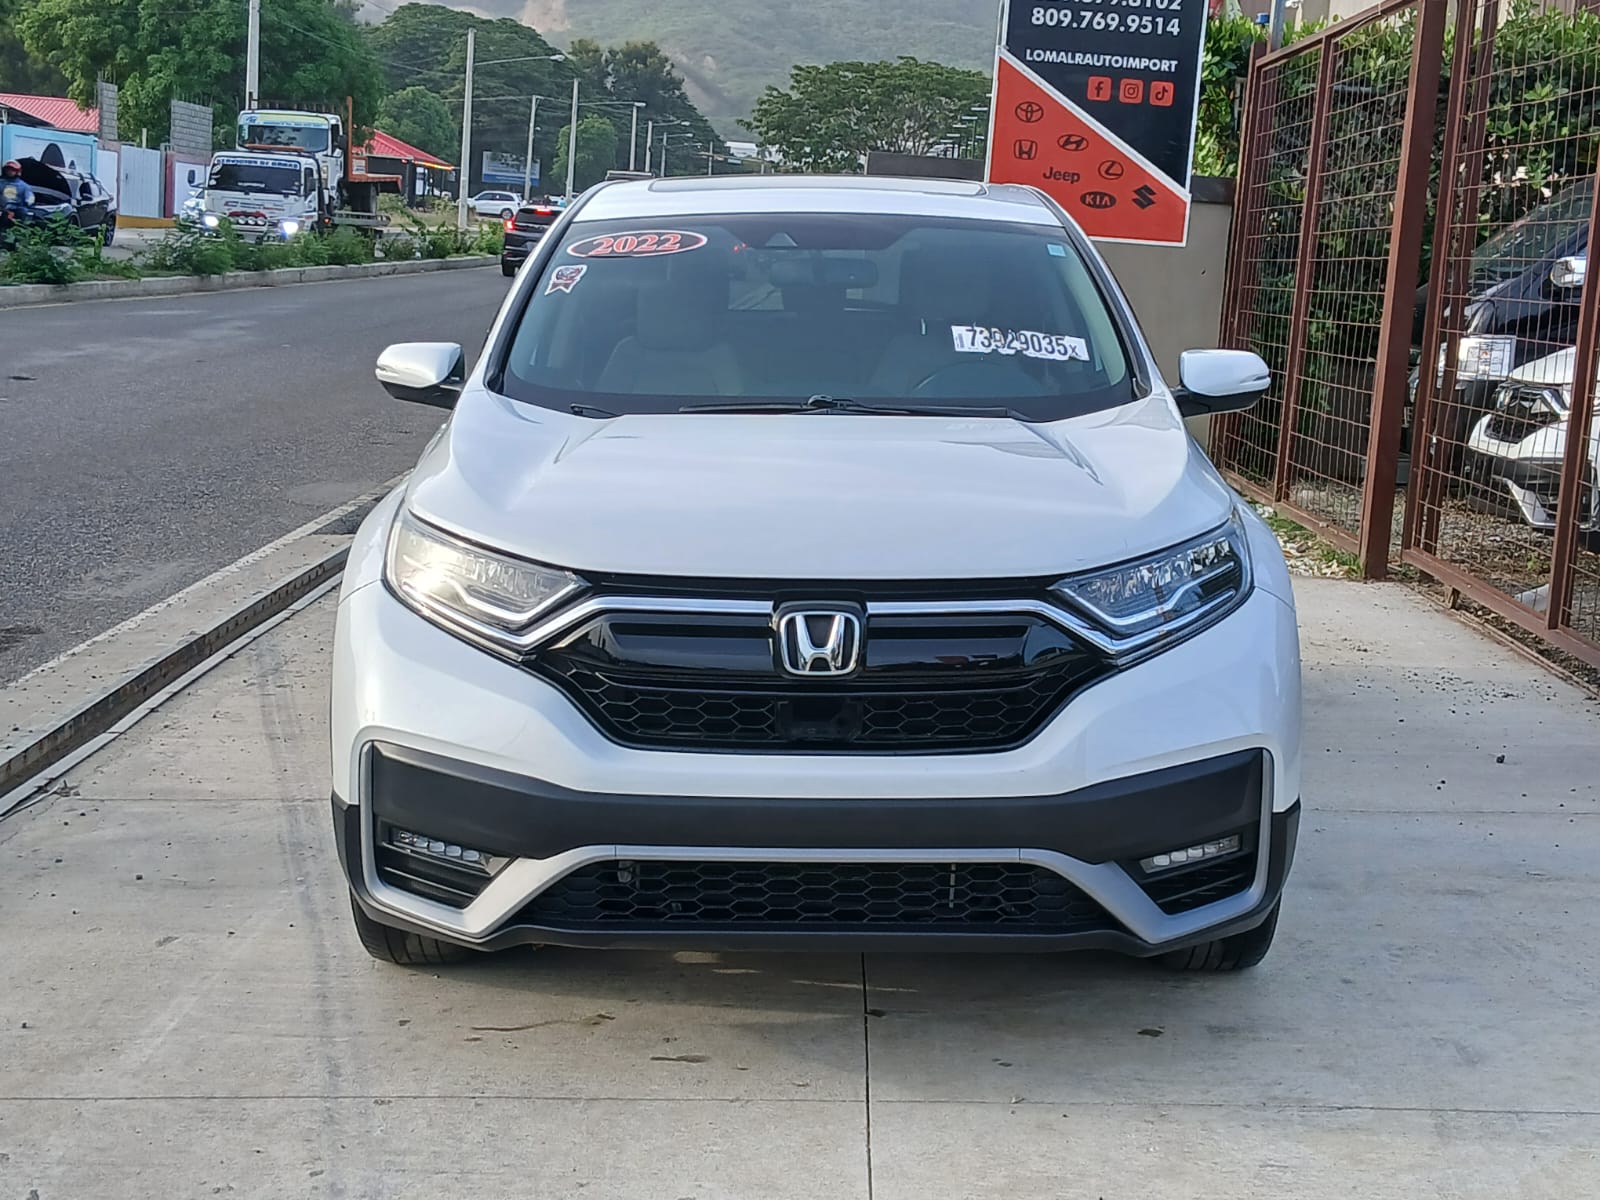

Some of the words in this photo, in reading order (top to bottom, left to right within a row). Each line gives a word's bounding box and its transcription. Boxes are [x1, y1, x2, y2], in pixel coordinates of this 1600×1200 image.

[1031, 7, 1180, 36] 809.769.9514
[1025, 49, 1178, 72] LOMALRAUTOIMPORT
[1042, 167, 1081, 184] Jeep
[1085, 195, 1111, 205] KIA
[588, 233, 682, 256] 2022
